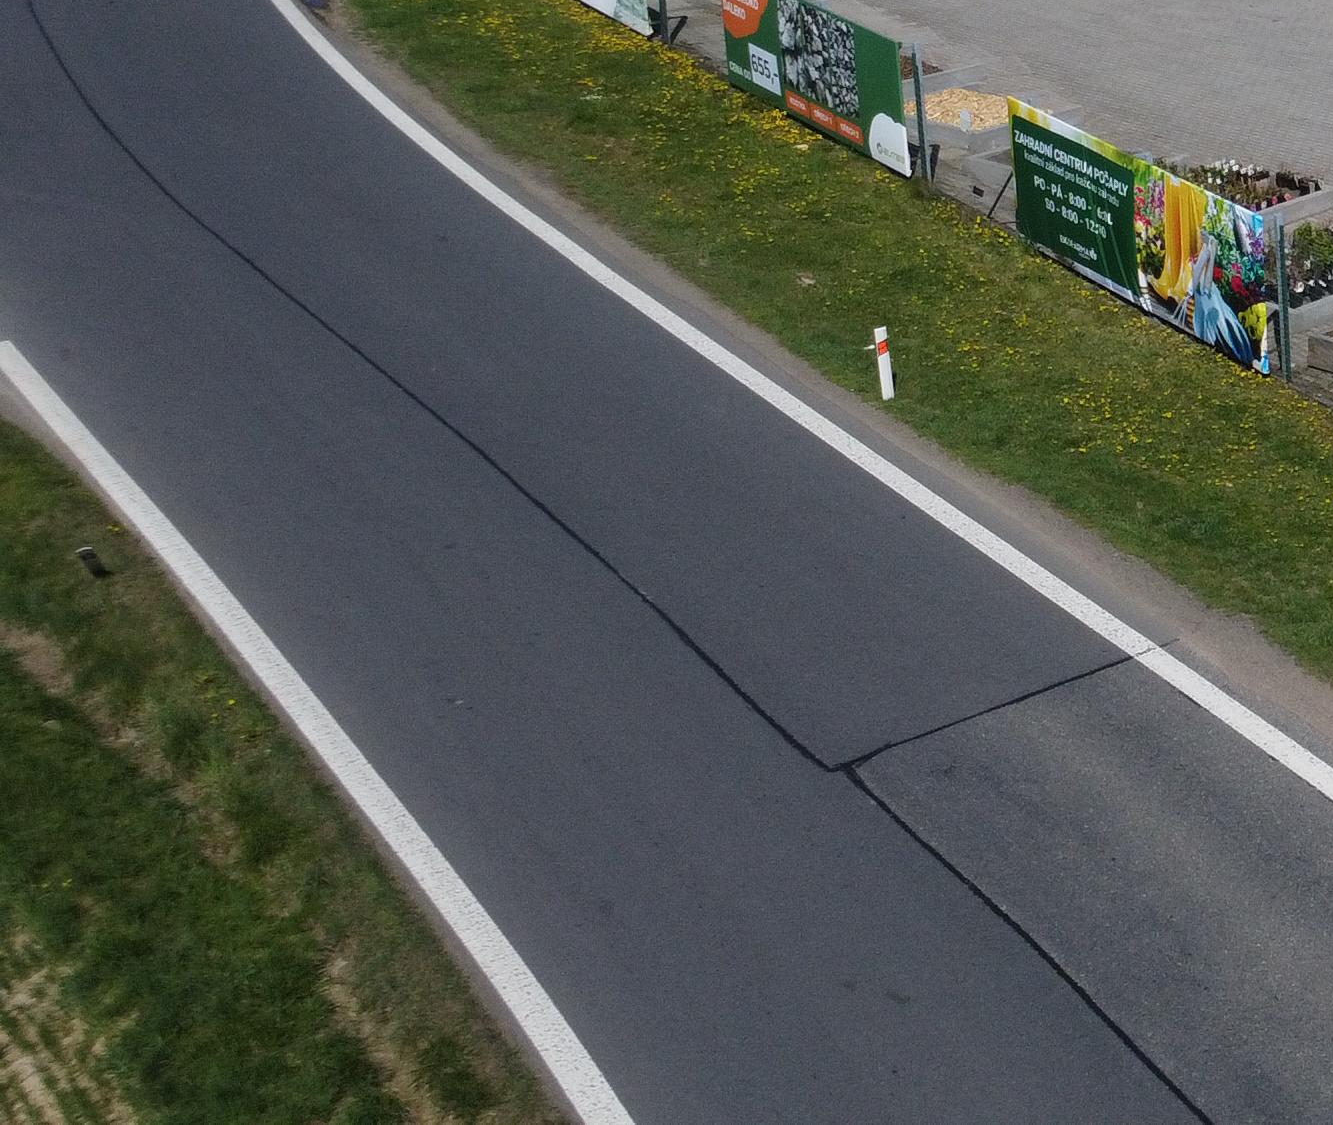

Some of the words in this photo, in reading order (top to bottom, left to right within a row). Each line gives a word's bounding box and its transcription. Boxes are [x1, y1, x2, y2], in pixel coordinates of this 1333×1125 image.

[729, 61, 743, 76] CENA
[752, 54, 778, 85] 655,-
[1014, 130, 1053, 159] ZAHRADNÍ
[1054, 148, 1093, 178] CENTRUM
[1093, 167, 1129, 197] POČAPLY
[1023, 149, 1045, 168] kvalitní
[1065, 171, 1075, 182] pro
[1034, 175, 1046, 190] PO
[1051, 183, 1063, 200] PÁ
[1069, 191, 1087, 210] 8:00
[1045, 197, 1055, 212] SO
[1061, 205, 1079, 224] 8:00
